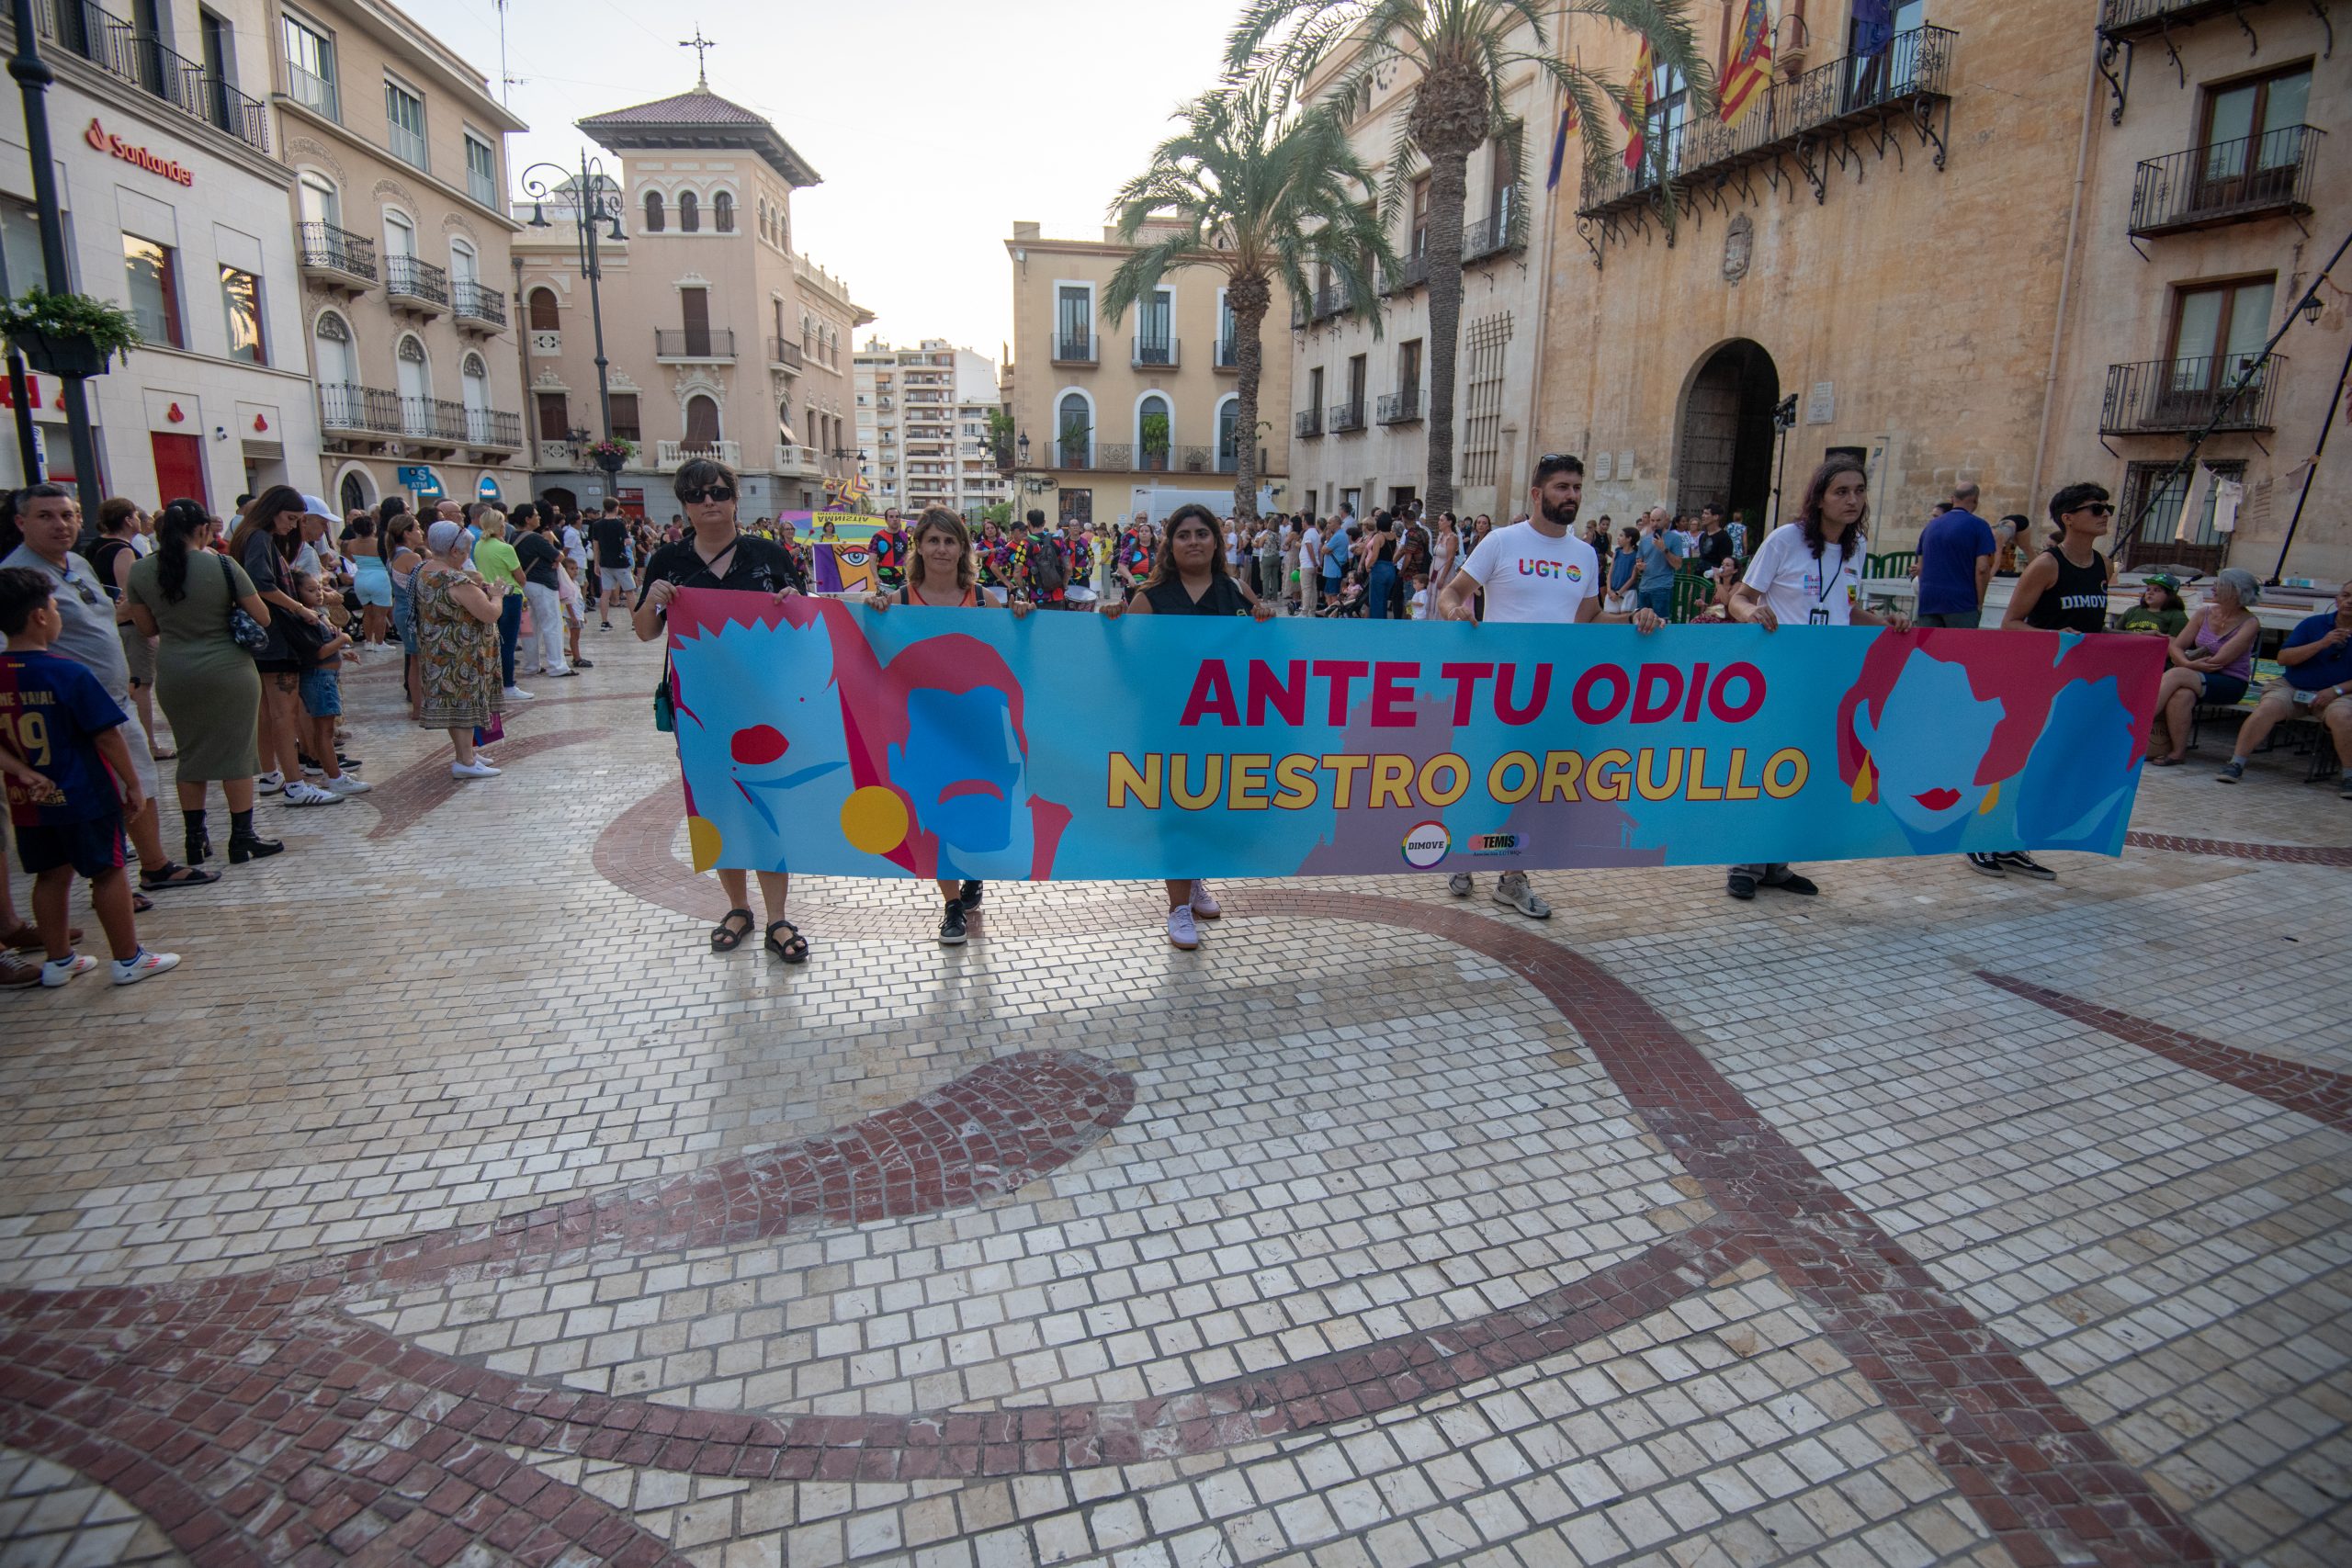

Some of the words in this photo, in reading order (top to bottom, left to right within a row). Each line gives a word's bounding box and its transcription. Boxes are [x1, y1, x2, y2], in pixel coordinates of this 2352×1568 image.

[109, 133, 194, 187] Santander
[1519, 558, 1563, 580] UGT
[1179, 658, 1422, 728] ANTE
[1439, 662, 1555, 728] TU
[1571, 660, 1767, 726] ODIO
[1107, 750, 1470, 810] NUESTRO
[1487, 747, 1810, 805] ORGULLO
[1408, 840, 1445, 851] DIMOVE
[1483, 835, 1516, 849] TEMIS
